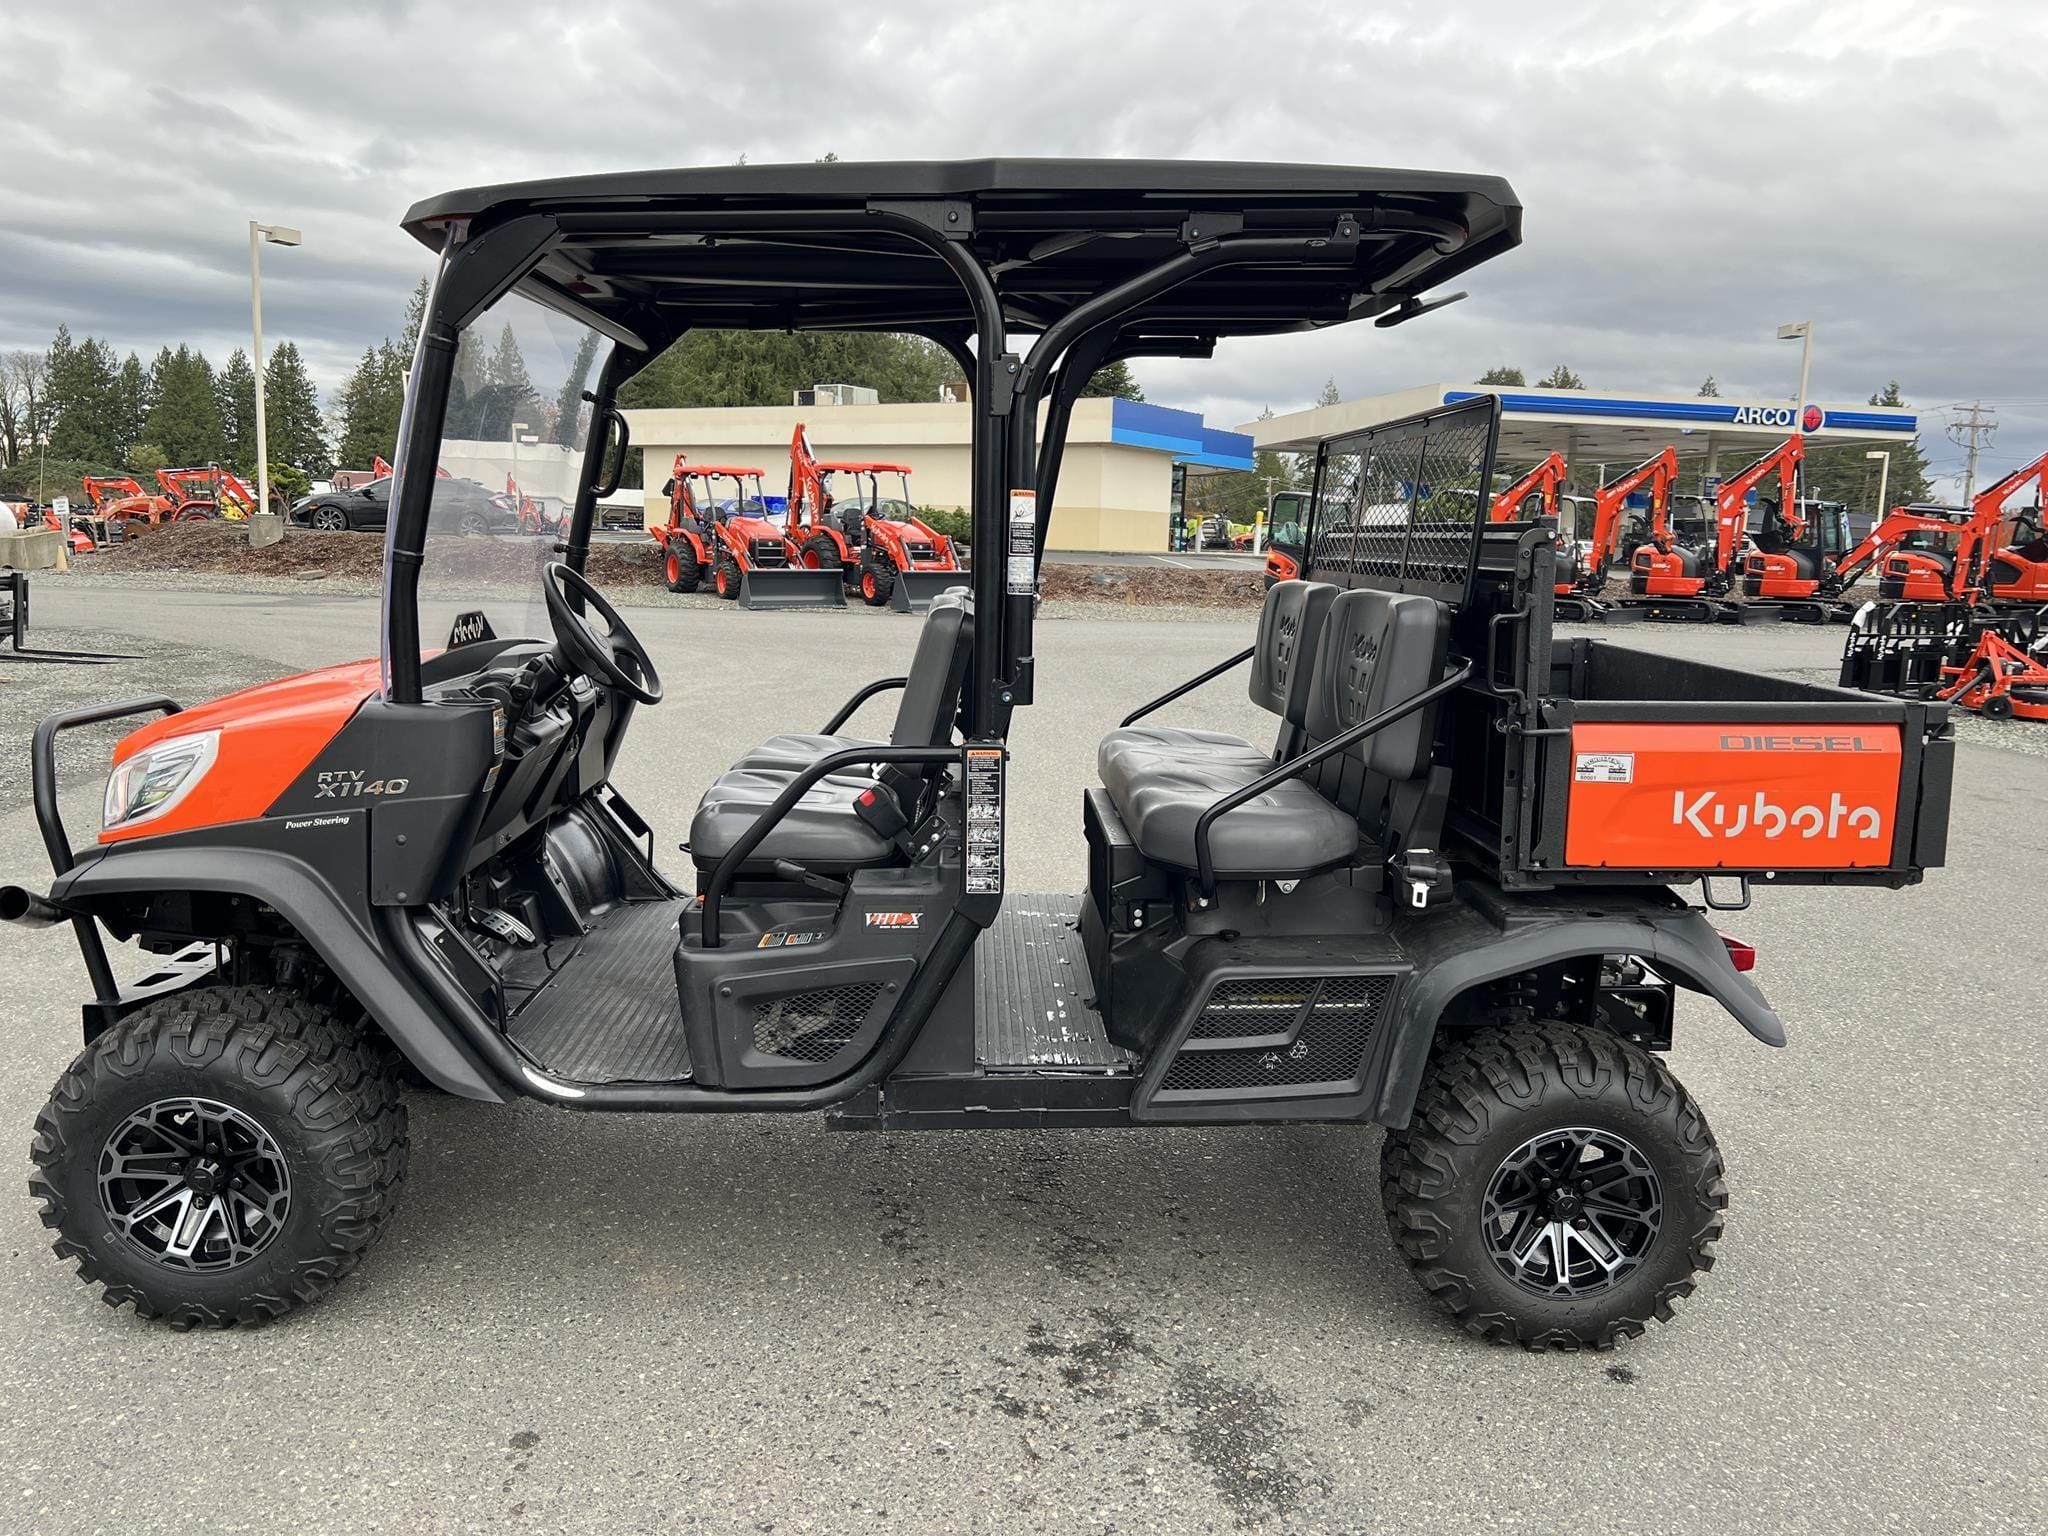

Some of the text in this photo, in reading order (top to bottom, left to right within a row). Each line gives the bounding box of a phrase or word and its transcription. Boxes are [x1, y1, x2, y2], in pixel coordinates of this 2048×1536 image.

[1733, 407, 1791, 426] ARCO
[1616, 478, 1639, 493] Kubota
[1720, 735, 1882, 751] DIESEL
[318, 770, 365, 782] RTV
[314, 779, 409, 798] X1140
[285, 816, 350, 829] Power Steering
[1672, 791, 1881, 839] Kubota
[865, 912, 923, 927] VHT-X
